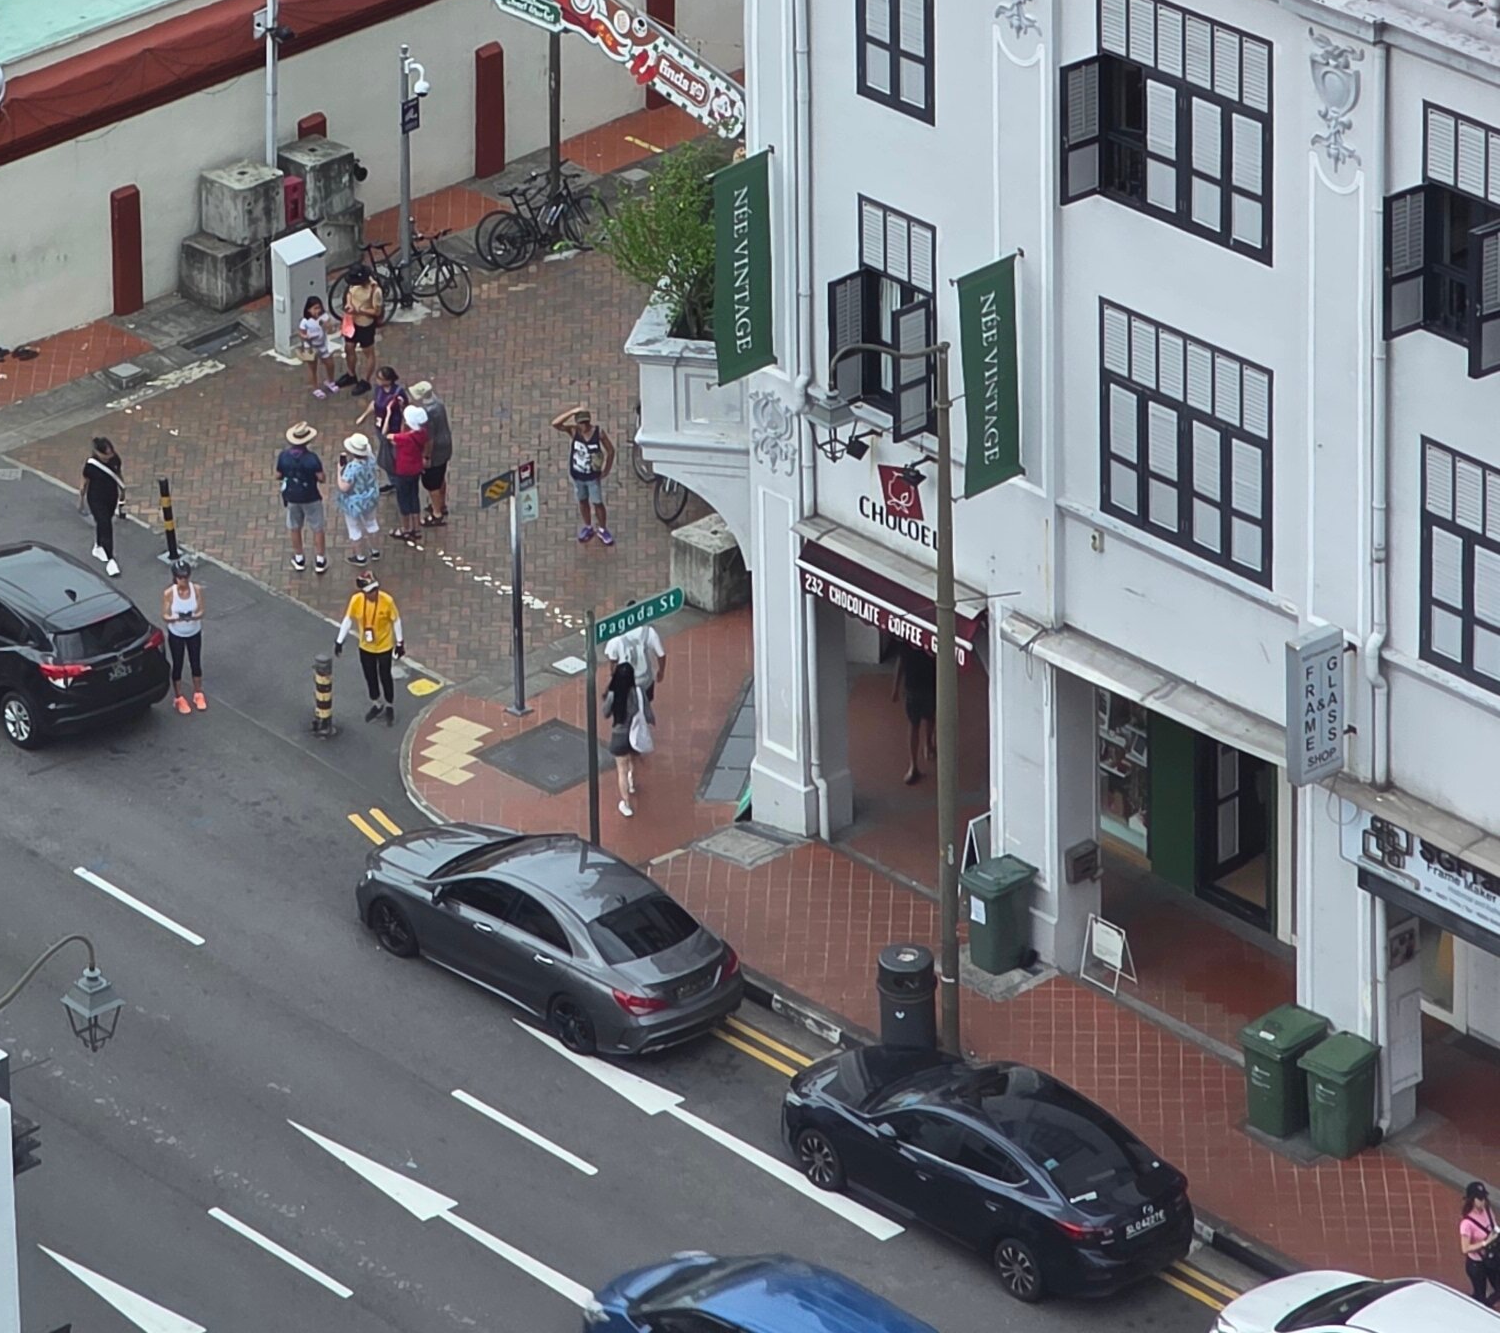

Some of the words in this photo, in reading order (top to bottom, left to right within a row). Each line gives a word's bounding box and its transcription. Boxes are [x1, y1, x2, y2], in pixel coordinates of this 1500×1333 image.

[734, 185, 753, 239] NÉE
[733, 238, 754, 354] VINTAGE
[980, 290, 1001, 347] NÉE
[982, 346, 1001, 466] VINTAGE
[598, 604, 654, 639] Pagoda
[659, 593, 676, 613] St
[804, 573, 824, 598] 232
[828, 585, 880, 626] CHOCOLATE
[887, 614, 923, 649] COFFEE
[1304, 665, 1317, 752] FRAME
[1316, 698, 1326, 712] &
[1326, 655, 1338, 742] GLASS
[1307, 747, 1337, 768] SHOP
[1426, 862, 1462, 887] Frame
[1464, 879, 1498, 904] Maker
